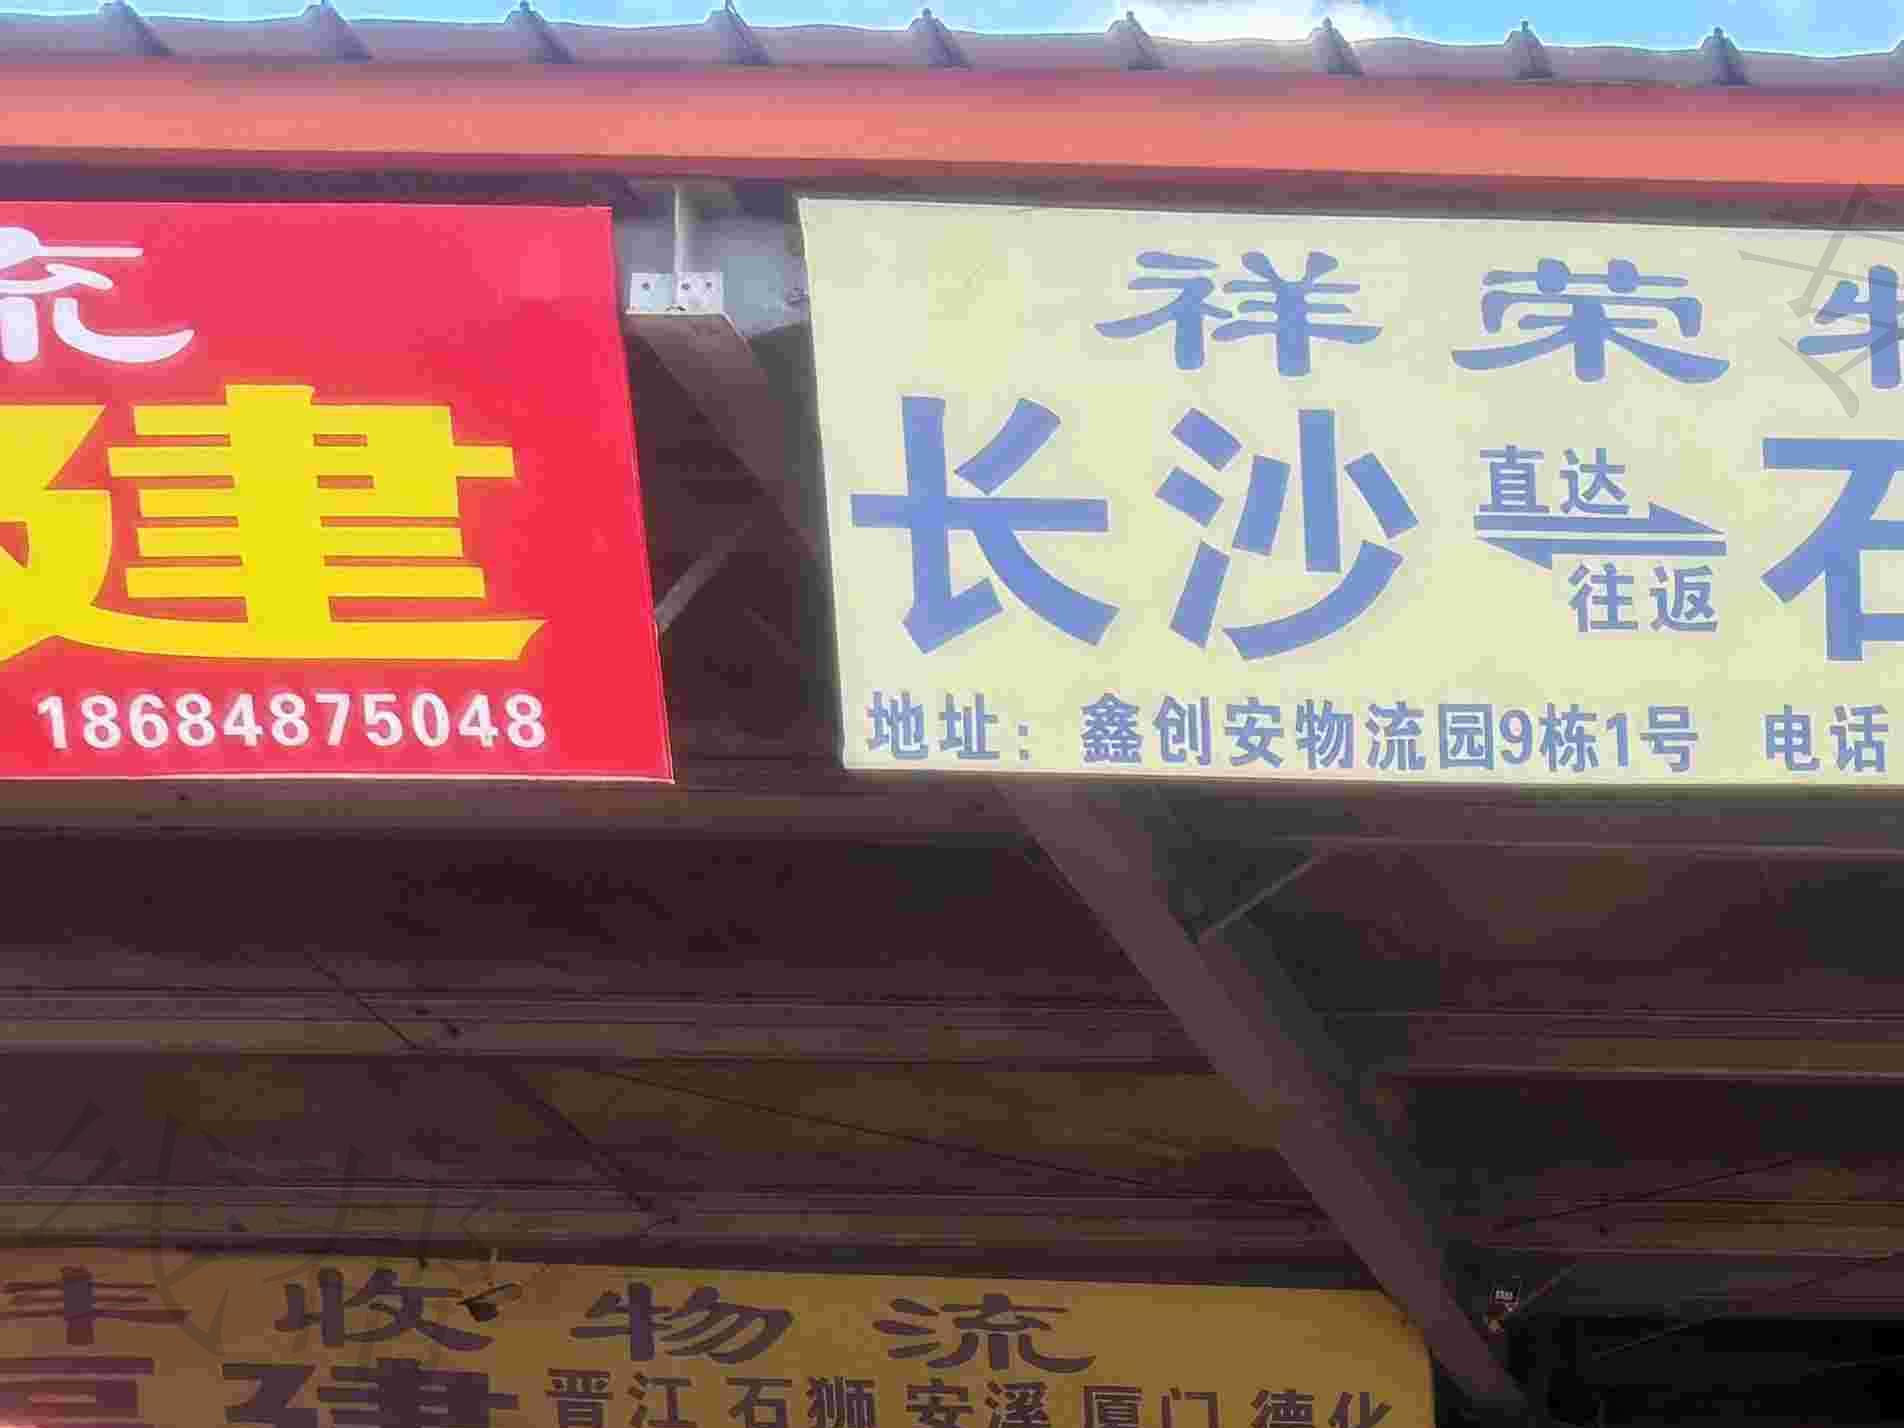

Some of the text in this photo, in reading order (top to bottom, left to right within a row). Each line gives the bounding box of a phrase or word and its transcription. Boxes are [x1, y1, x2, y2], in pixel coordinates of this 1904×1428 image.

[0, 385, 548, 661] 建
[1478, 445, 1631, 518] 直达
[851, 394, 1420, 661] 长沙
[1568, 564, 1720, 632] 往返
[36, 693, 547, 750] 18684875048
[2, 1265, 1096, 1374] 丰收物流
